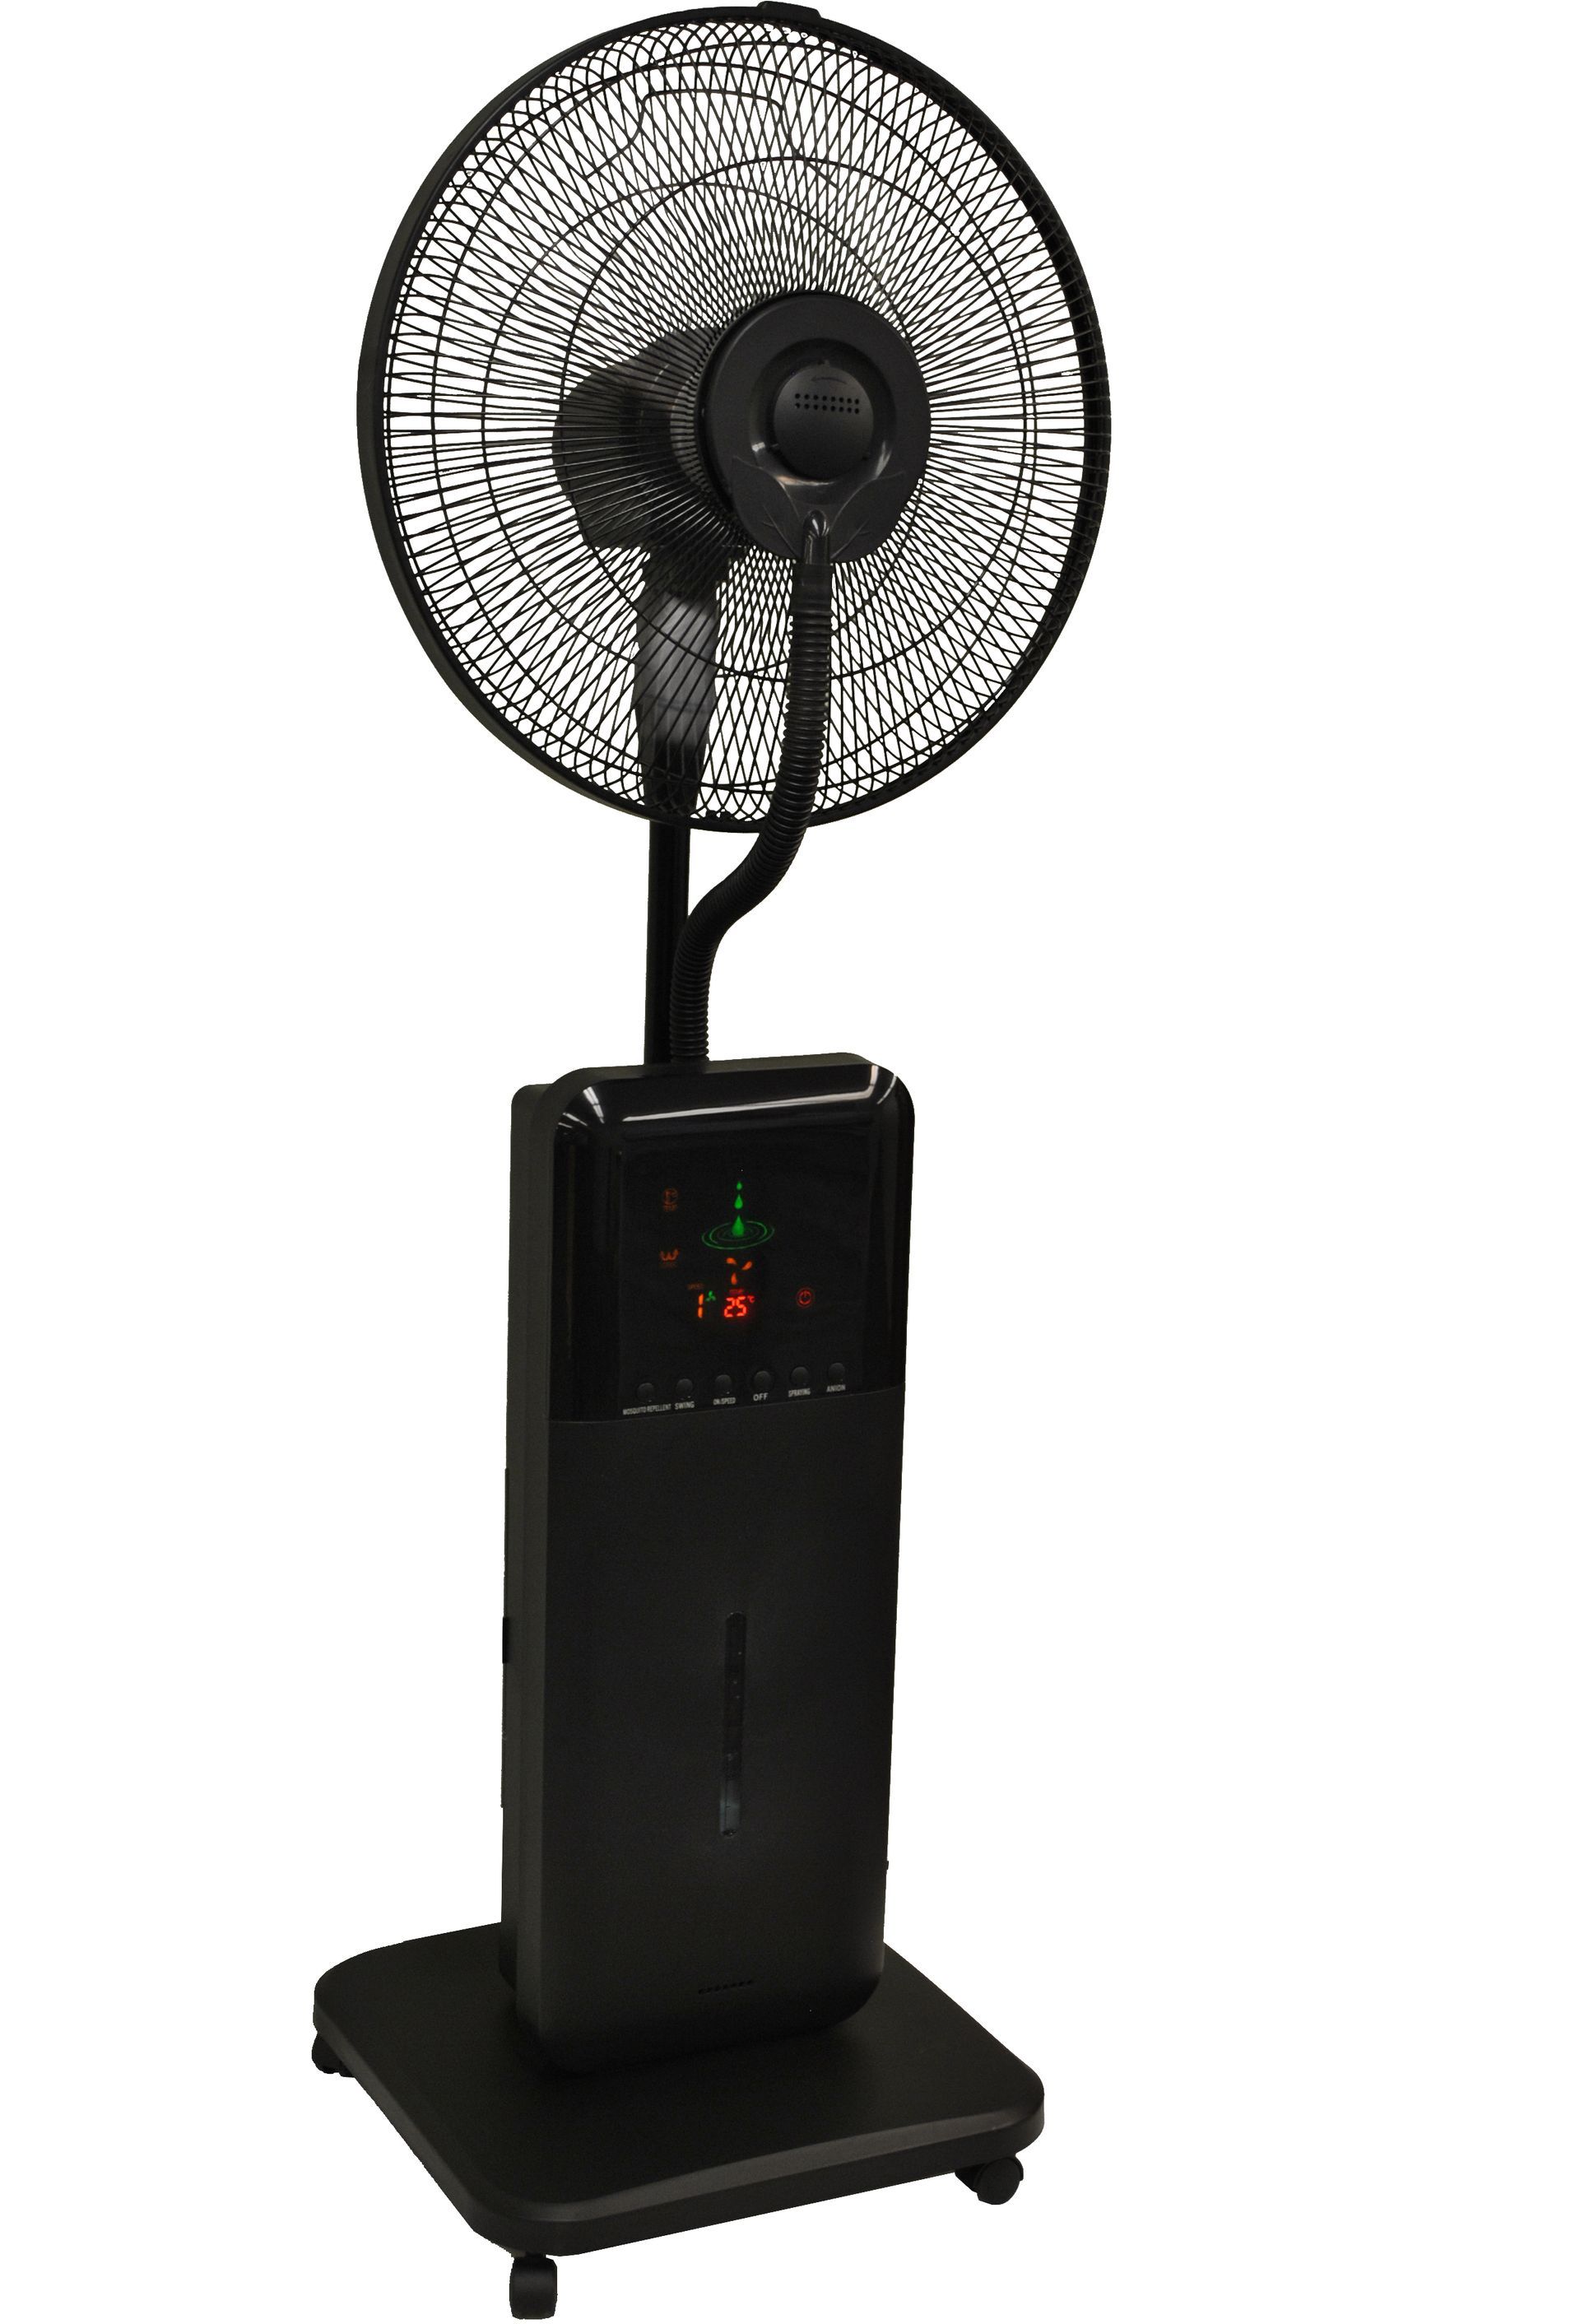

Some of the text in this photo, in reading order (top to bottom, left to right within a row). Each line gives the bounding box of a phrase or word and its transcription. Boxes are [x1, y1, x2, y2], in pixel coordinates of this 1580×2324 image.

[825, 1383, 846, 1392] ANION
[753, 1392, 769, 1401] OFF
[788, 1387, 811, 1398] SPRAYING
[674, 1401, 695, 1410] SWING
